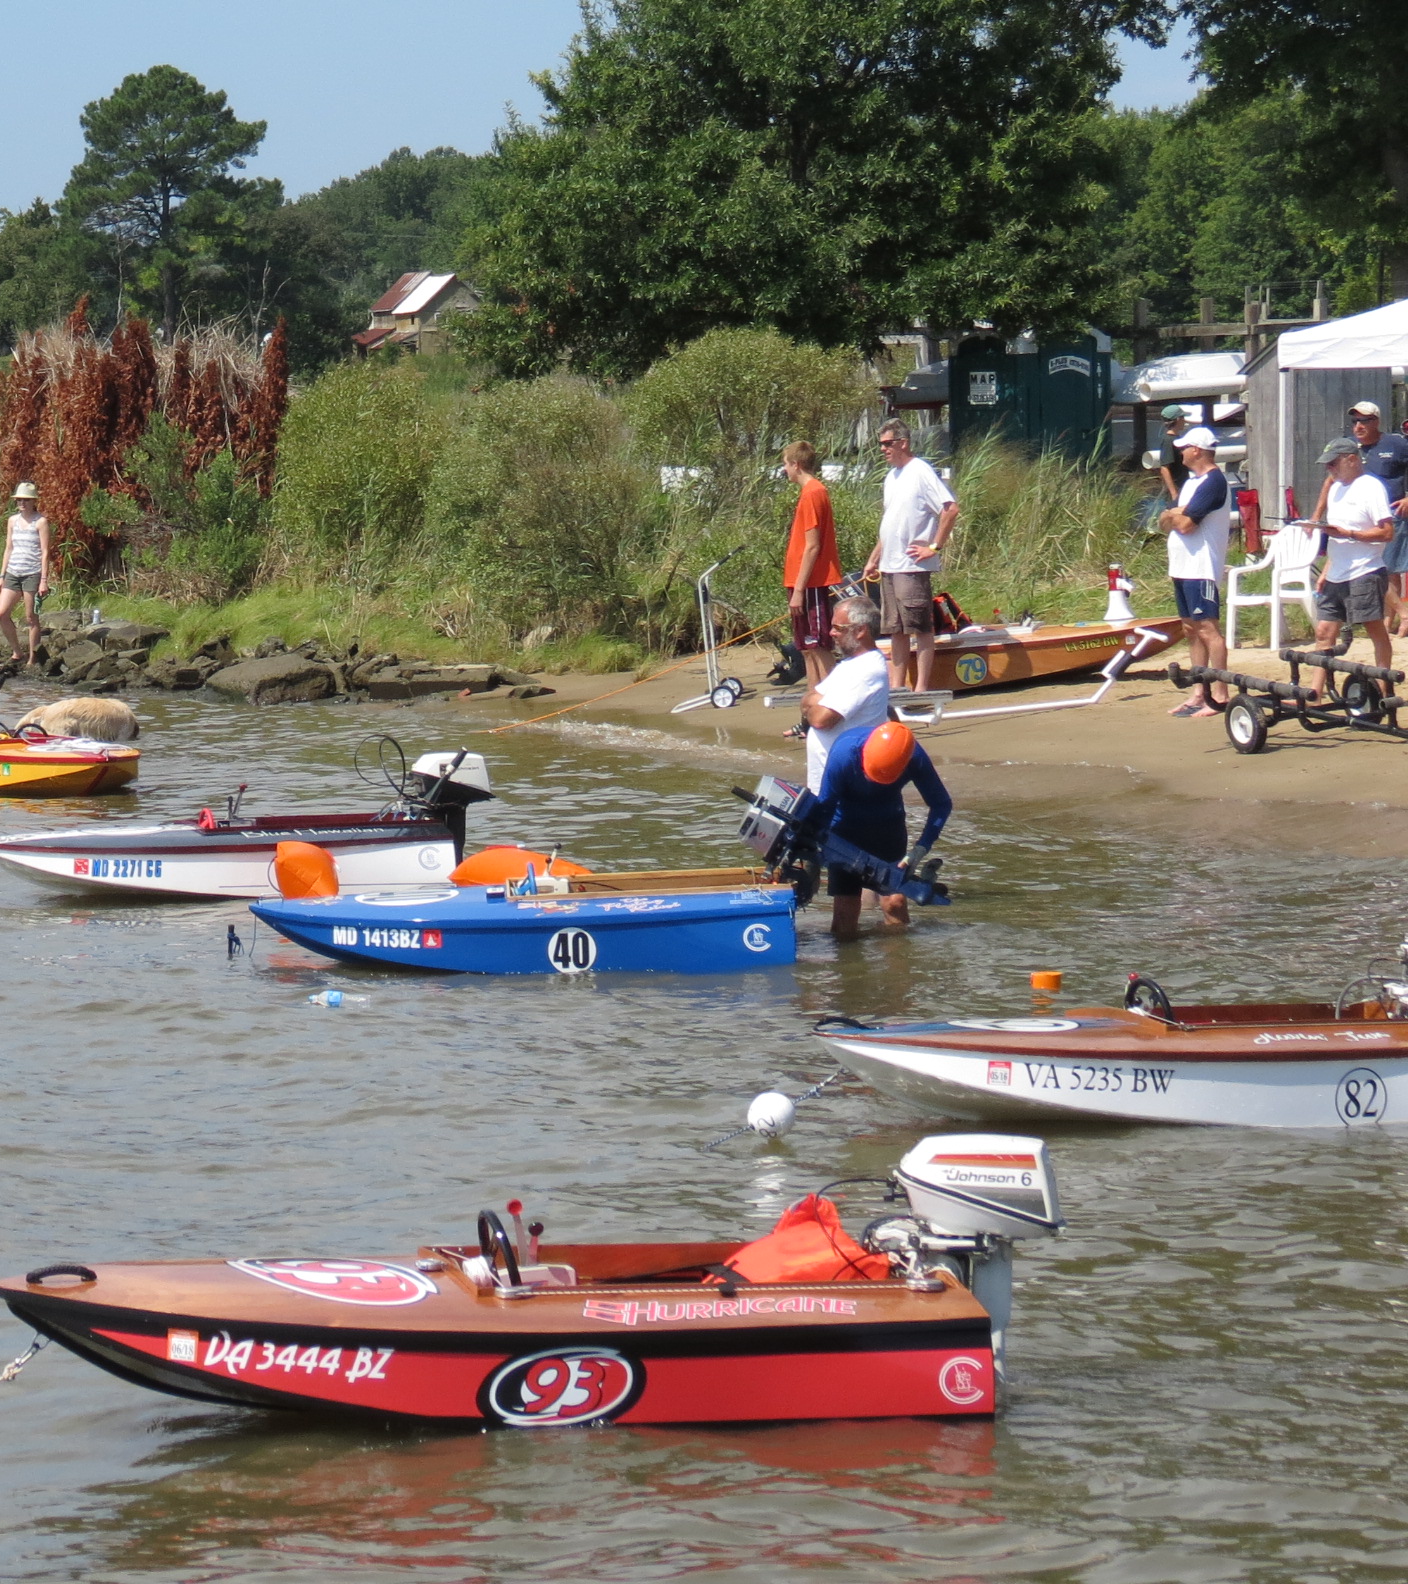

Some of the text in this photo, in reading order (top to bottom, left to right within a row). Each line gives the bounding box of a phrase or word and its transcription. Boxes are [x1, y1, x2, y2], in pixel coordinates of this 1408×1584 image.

[1064, 642, 1078, 653] VA
[1103, 636, 1119, 647] BW
[958, 657, 986, 682] 79
[92, 859, 162, 878] MD 2271 CG
[333, 926, 421, 949] MD 1413BZ
[553, 932, 590, 969] 40
[1024, 1062, 1175, 1094] VA 5235 BW
[1344, 1078, 1378, 1119] 82
[946, 1168, 1033, 1187] Johnson 6
[625, 1296, 857, 1326] HURRICANE
[204, 1330, 395, 1384] VA 3444 BZ
[524, 1357, 606, 1417] 93
